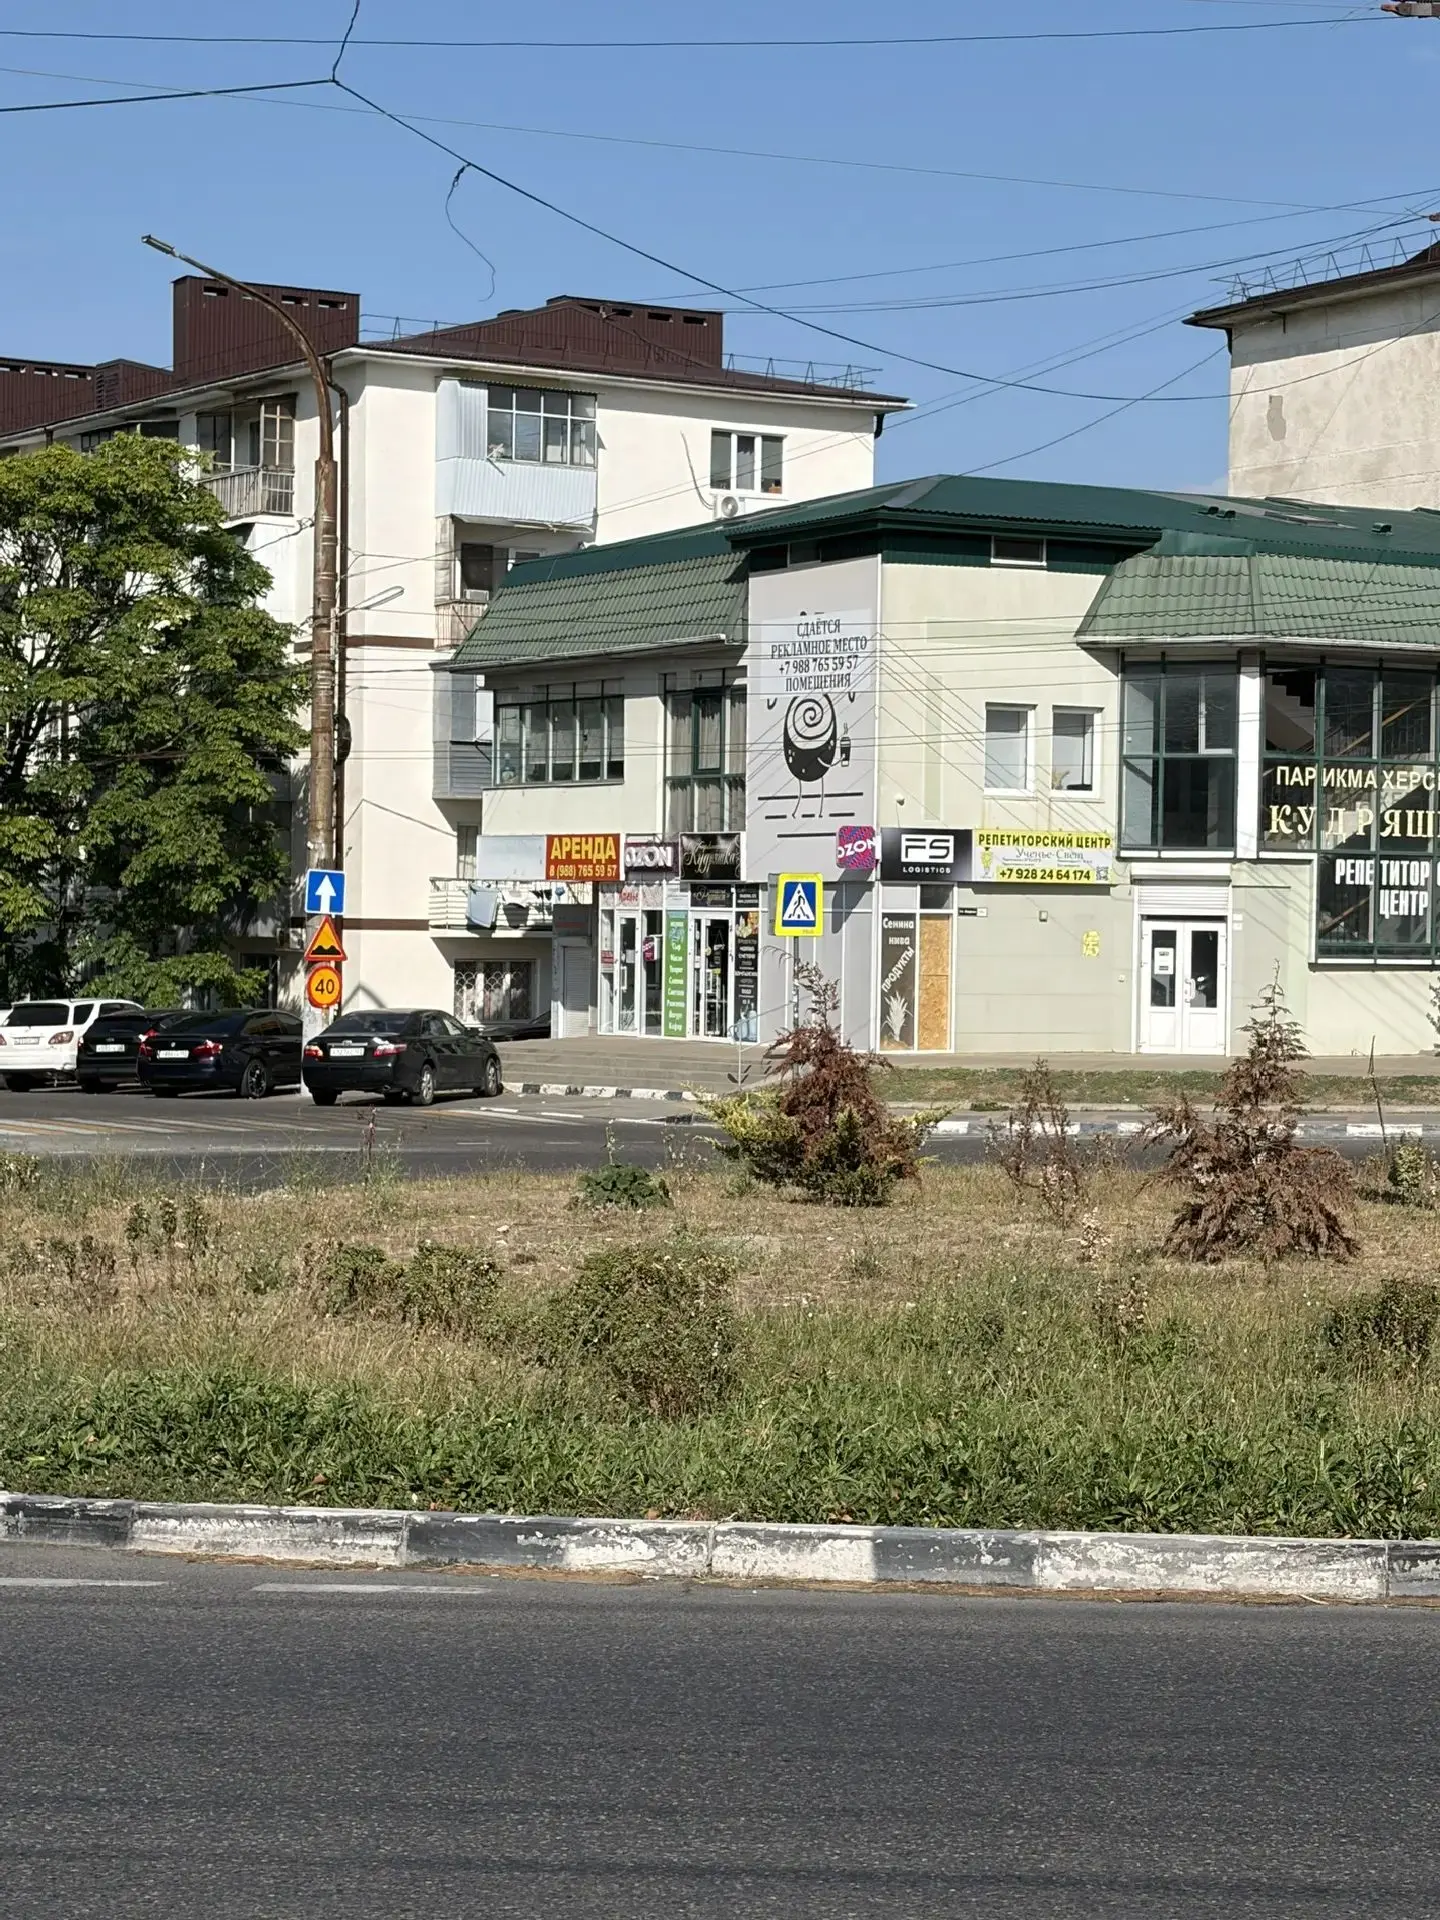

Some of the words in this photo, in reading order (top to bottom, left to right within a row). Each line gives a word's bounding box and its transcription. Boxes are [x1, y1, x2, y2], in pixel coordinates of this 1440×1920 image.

[797, 619, 841, 639] СДАЁТСЯ
[771, 640, 833, 659] РЕКЛАМНОЕ
[834, 636, 867, 654] МЕСТО
[779, 661, 790, 675] +7
[793, 659, 810, 674] 988
[812, 657, 830, 673] 765
[832, 656, 845, 671] 59
[846, 654, 858, 670] 57
[785, 673, 851, 692] ПОМЕЩЕНИЯ
[1269, 804, 1440, 843] КУДРЯШ
[551, 836, 617, 864] АРЕНДА
[904, 837, 951, 859] FS
[978, 833, 1072, 848] РЕПЕТИТОРСКИЙ
[1076, 836, 1111, 849] ЦЕНТР
[625, 845, 674, 868] OZON
[549, 866, 555, 877] 8
[556, 864, 576, 879] (988)
[578, 865, 593, 877] 765
[594, 865, 605, 877] 59
[607, 865, 617, 877] 57
[903, 866, 951, 874] LOGISTICS
[999, 868, 1014, 880] +7
[1016, 868, 1037, 880] 928
[1040, 869, 1054, 880] 24
[1056, 869, 1072, 881] 64
[1073, 870, 1091, 881] 174
[1335, 859, 1440, 887] РЕПЕТИТОР
[1379, 890, 1428, 919] ЦЕНТР
[883, 917, 914, 929] Сенина
[882, 945, 914, 992] ПРОДУКТЫ
[315, 978, 335, 995] 40
